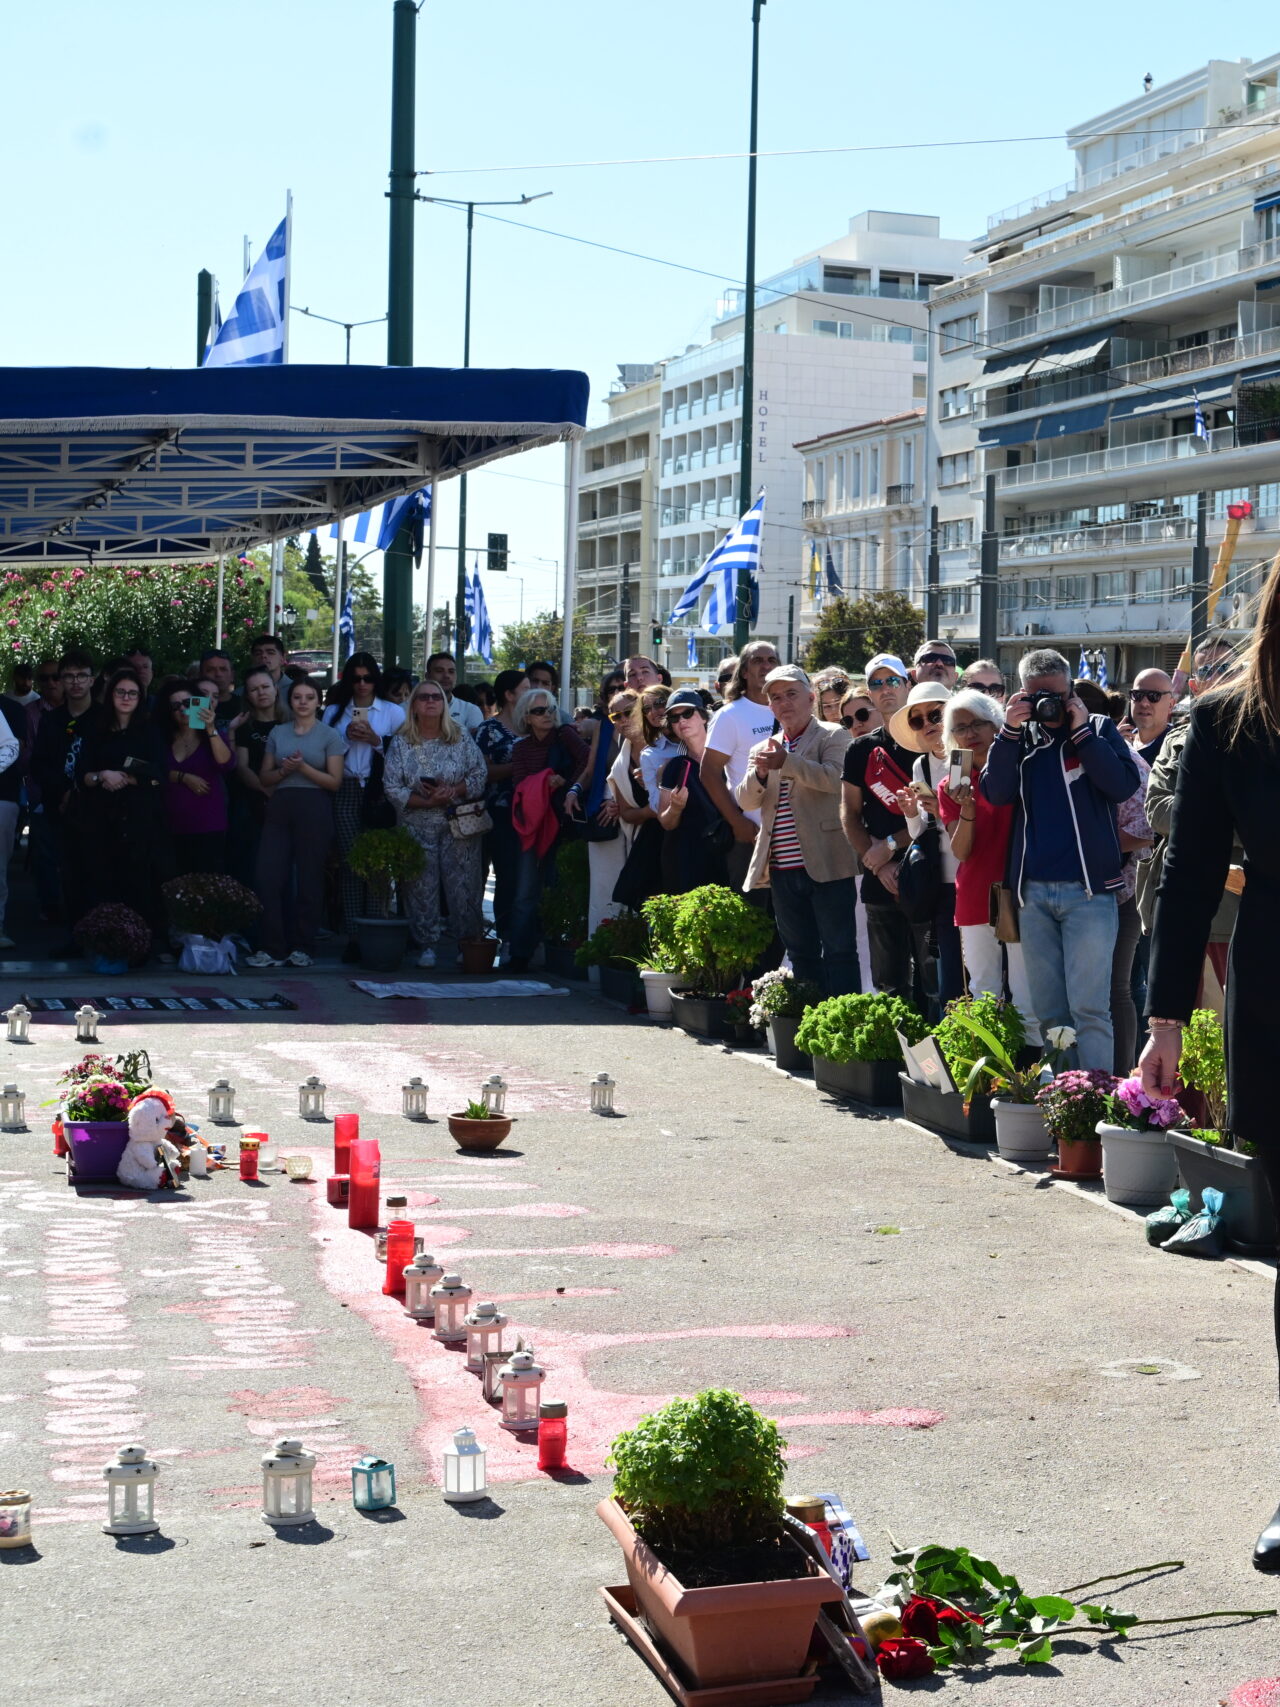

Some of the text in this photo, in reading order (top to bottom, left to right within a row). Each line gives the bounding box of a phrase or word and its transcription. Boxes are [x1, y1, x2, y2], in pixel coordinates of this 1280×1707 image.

[758, 390, 769, 463] HOTEL
[752, 725, 775, 735] FUNK
[870, 781, 898, 806] NIKE
